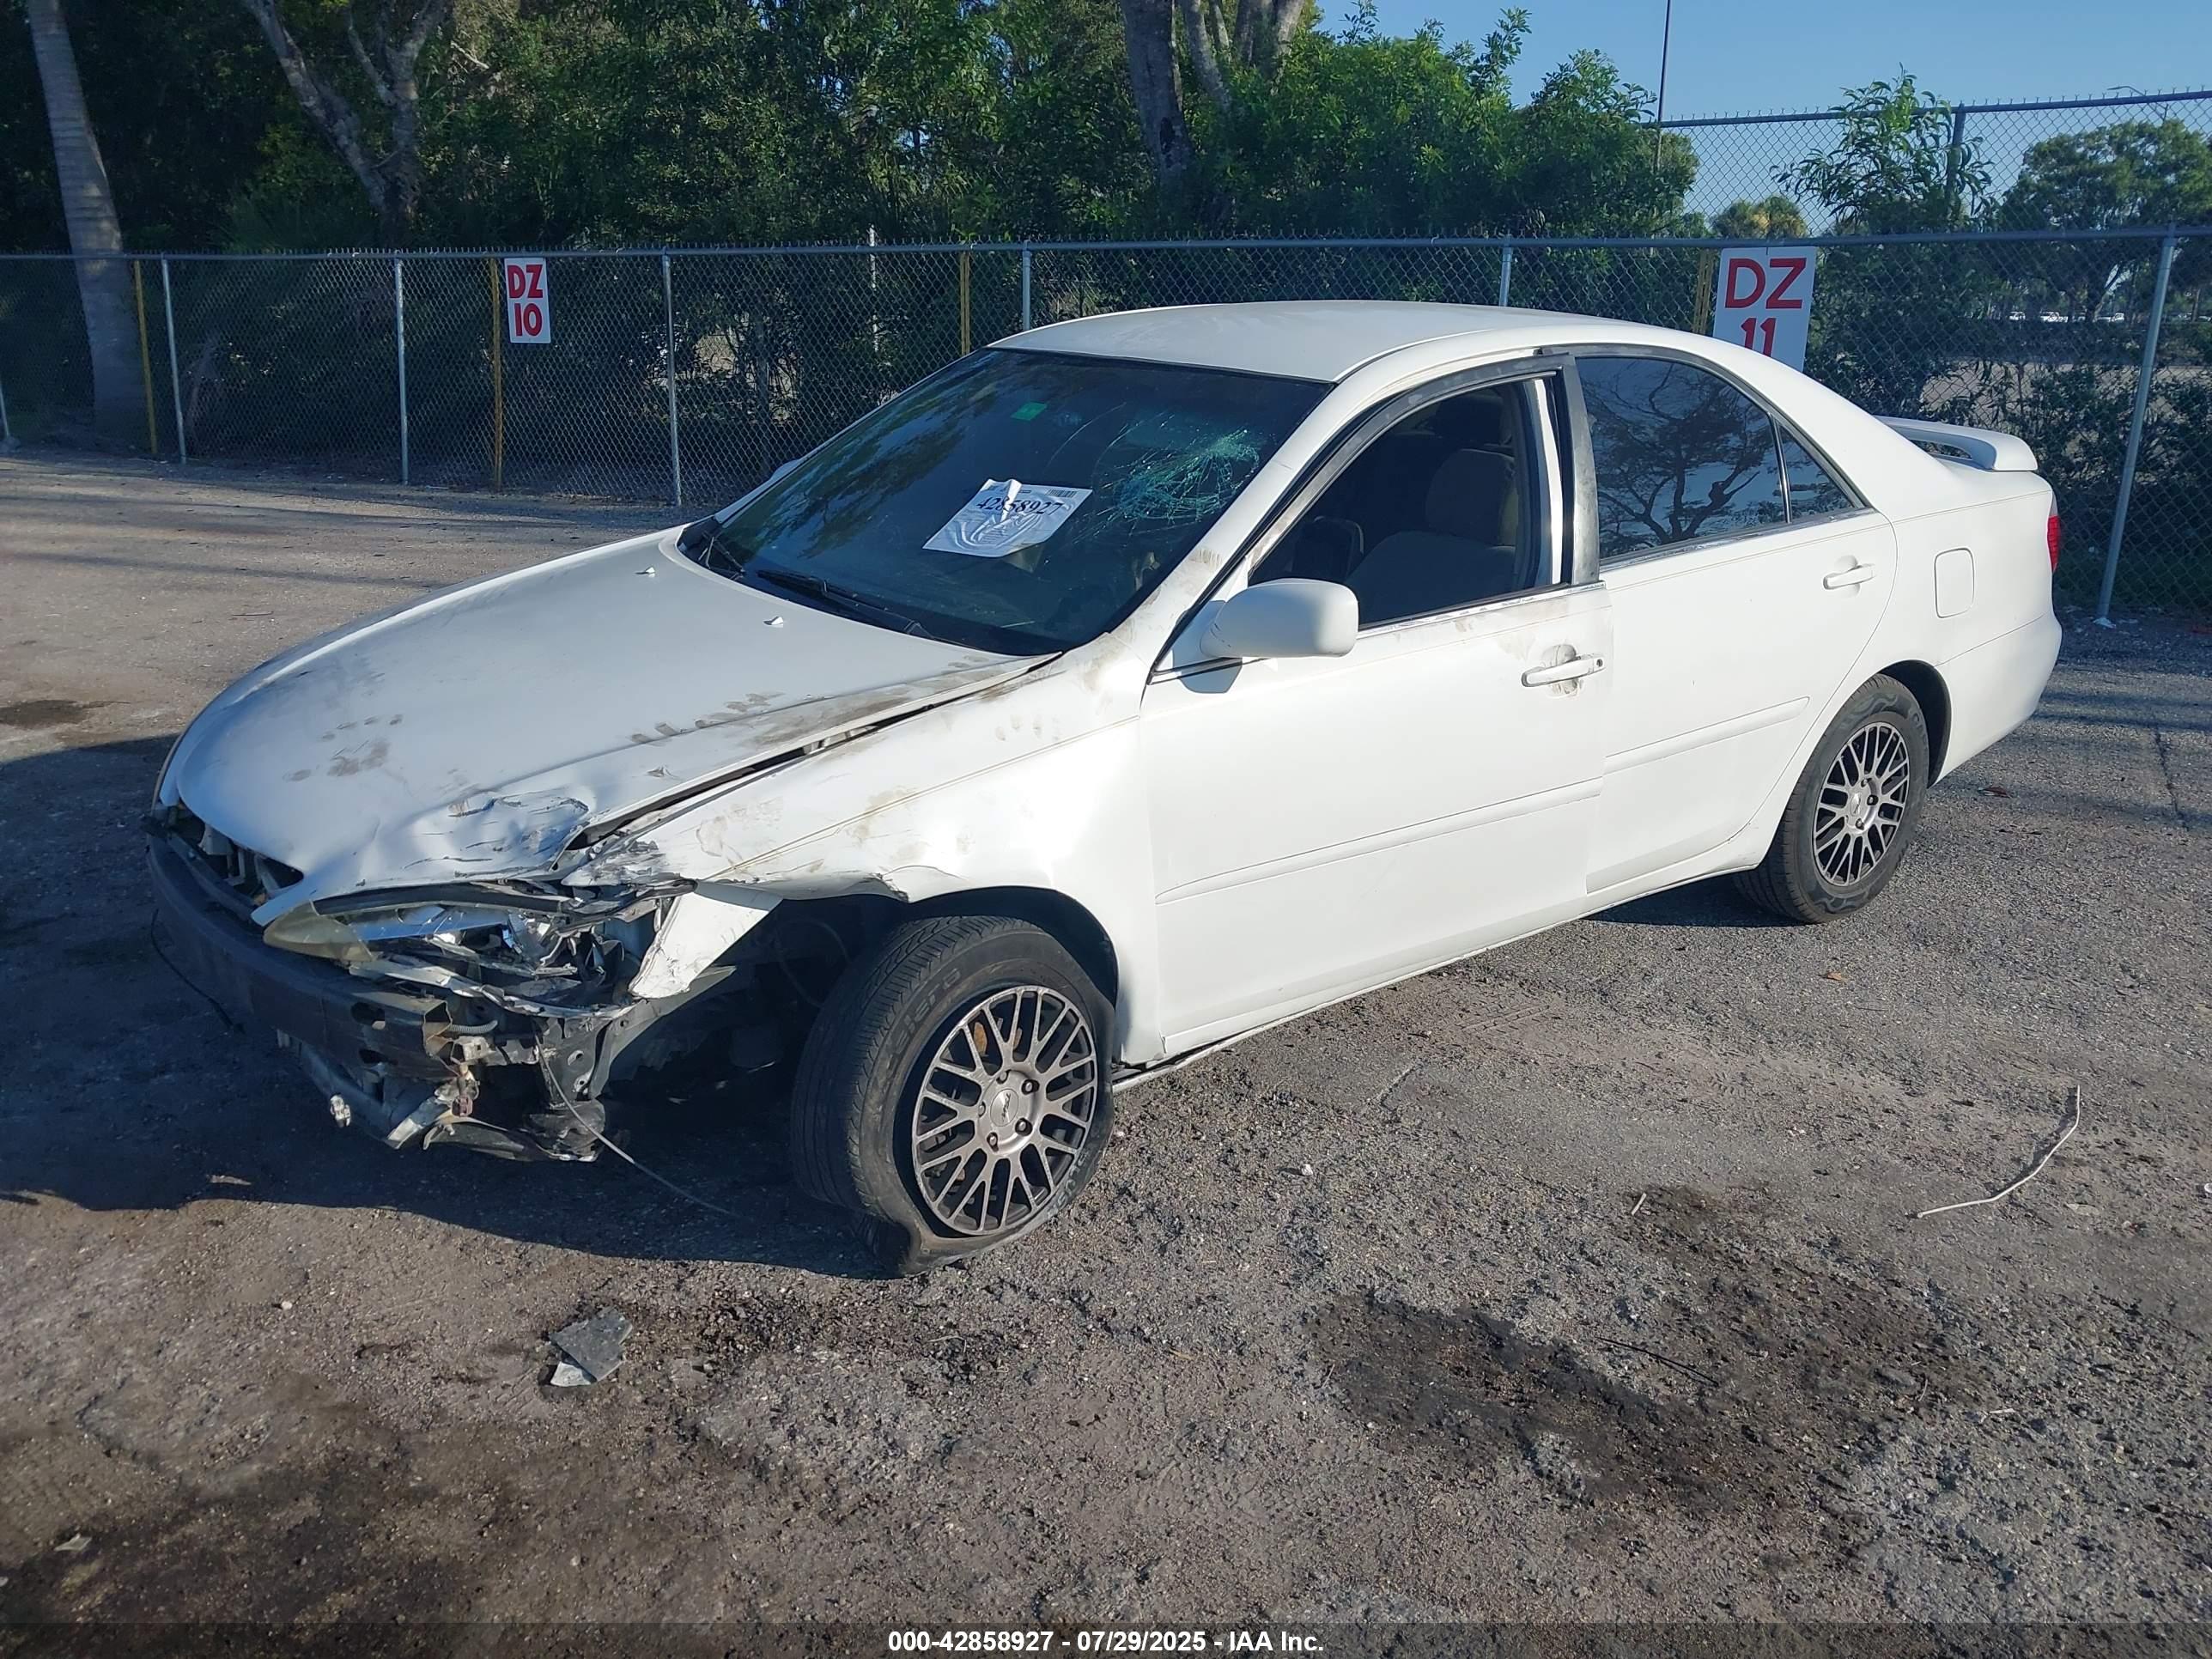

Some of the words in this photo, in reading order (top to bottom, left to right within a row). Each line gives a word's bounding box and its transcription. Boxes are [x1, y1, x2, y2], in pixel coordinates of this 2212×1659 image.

[507, 264, 544, 299] DZ
[1724, 257, 1808, 309] DZ
[514, 302, 543, 337] 10
[1740, 317, 1777, 357] 11
